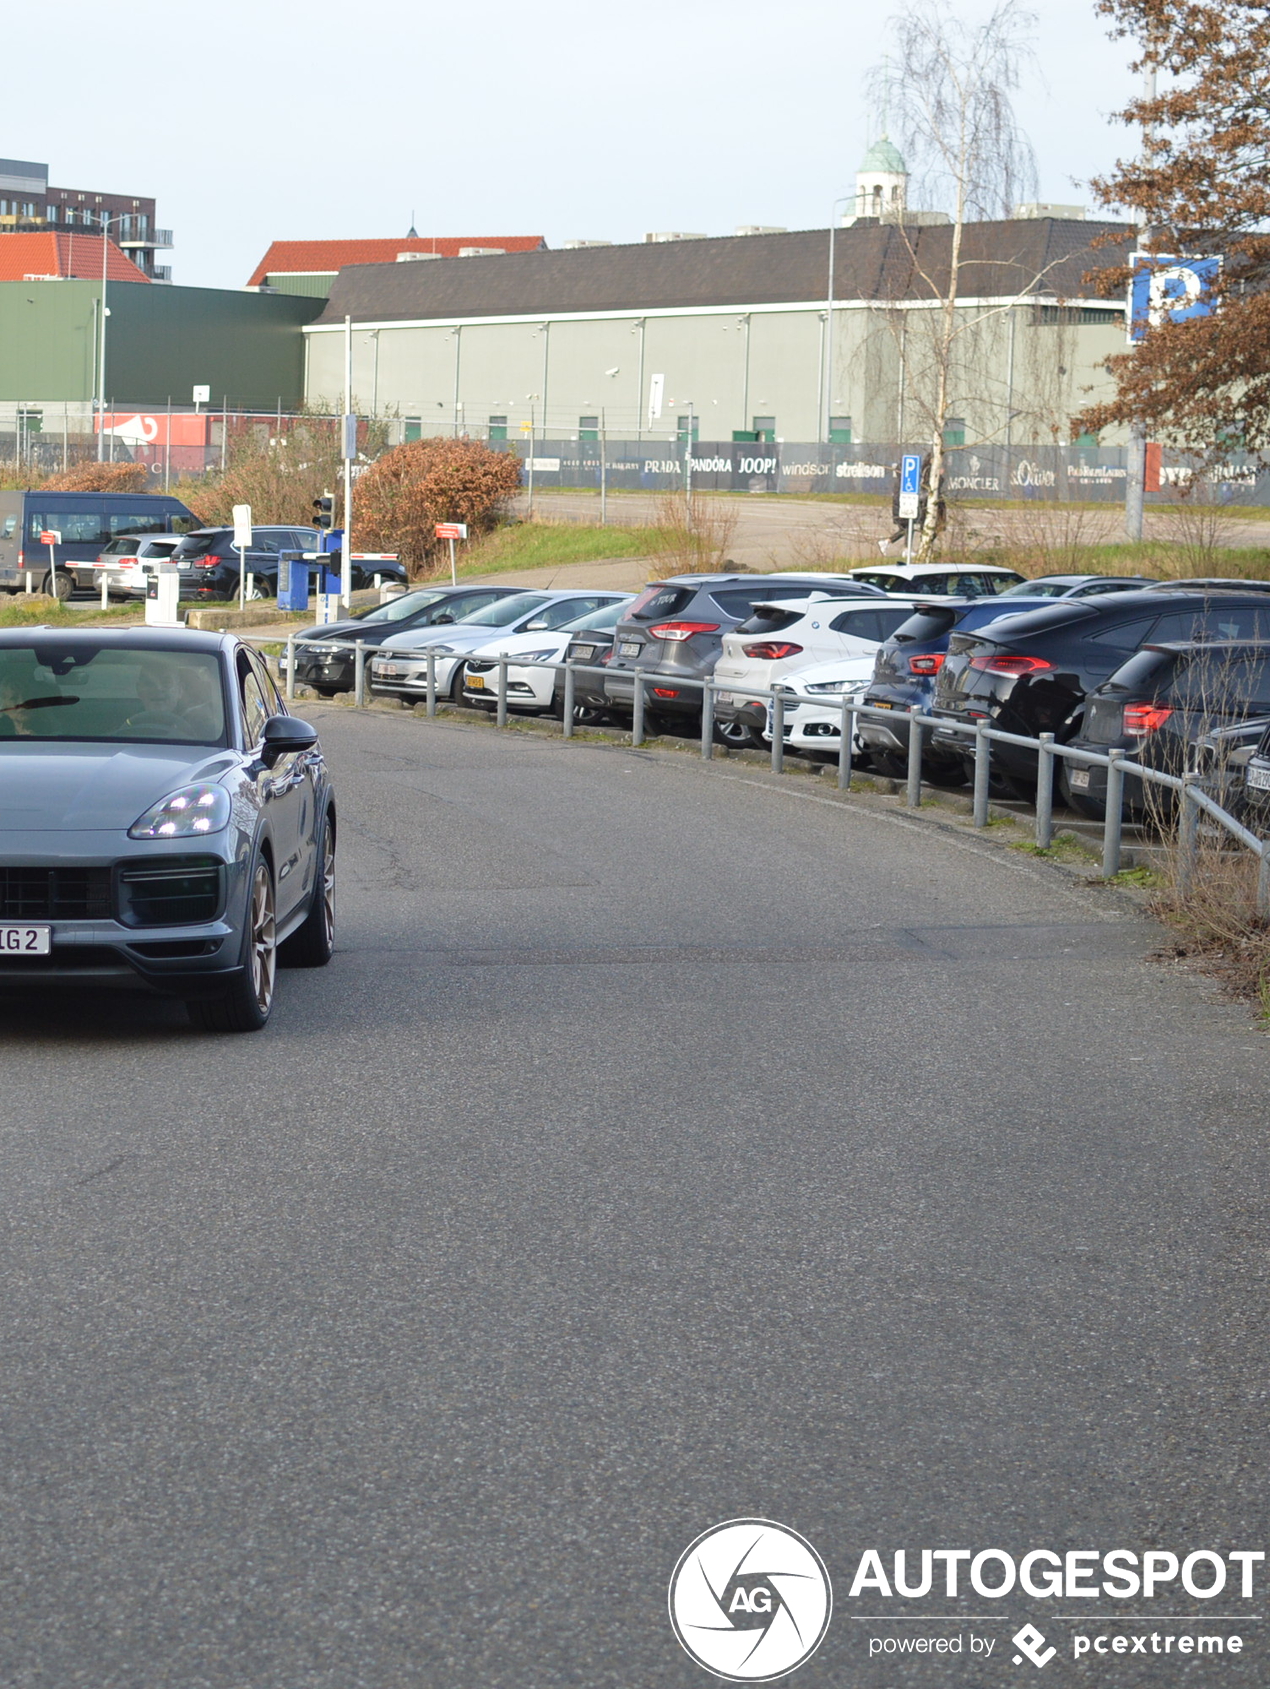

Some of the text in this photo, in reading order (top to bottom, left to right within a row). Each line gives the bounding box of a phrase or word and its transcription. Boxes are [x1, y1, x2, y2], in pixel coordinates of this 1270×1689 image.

[1148, 266, 1201, 327] P
[644, 460, 681, 474] PRADA
[690, 456, 733, 472] PANDORA
[738, 457, 777, 474] JOOP!
[905, 458, 916, 478] P
[947, 476, 1000, 491] MONCLER
